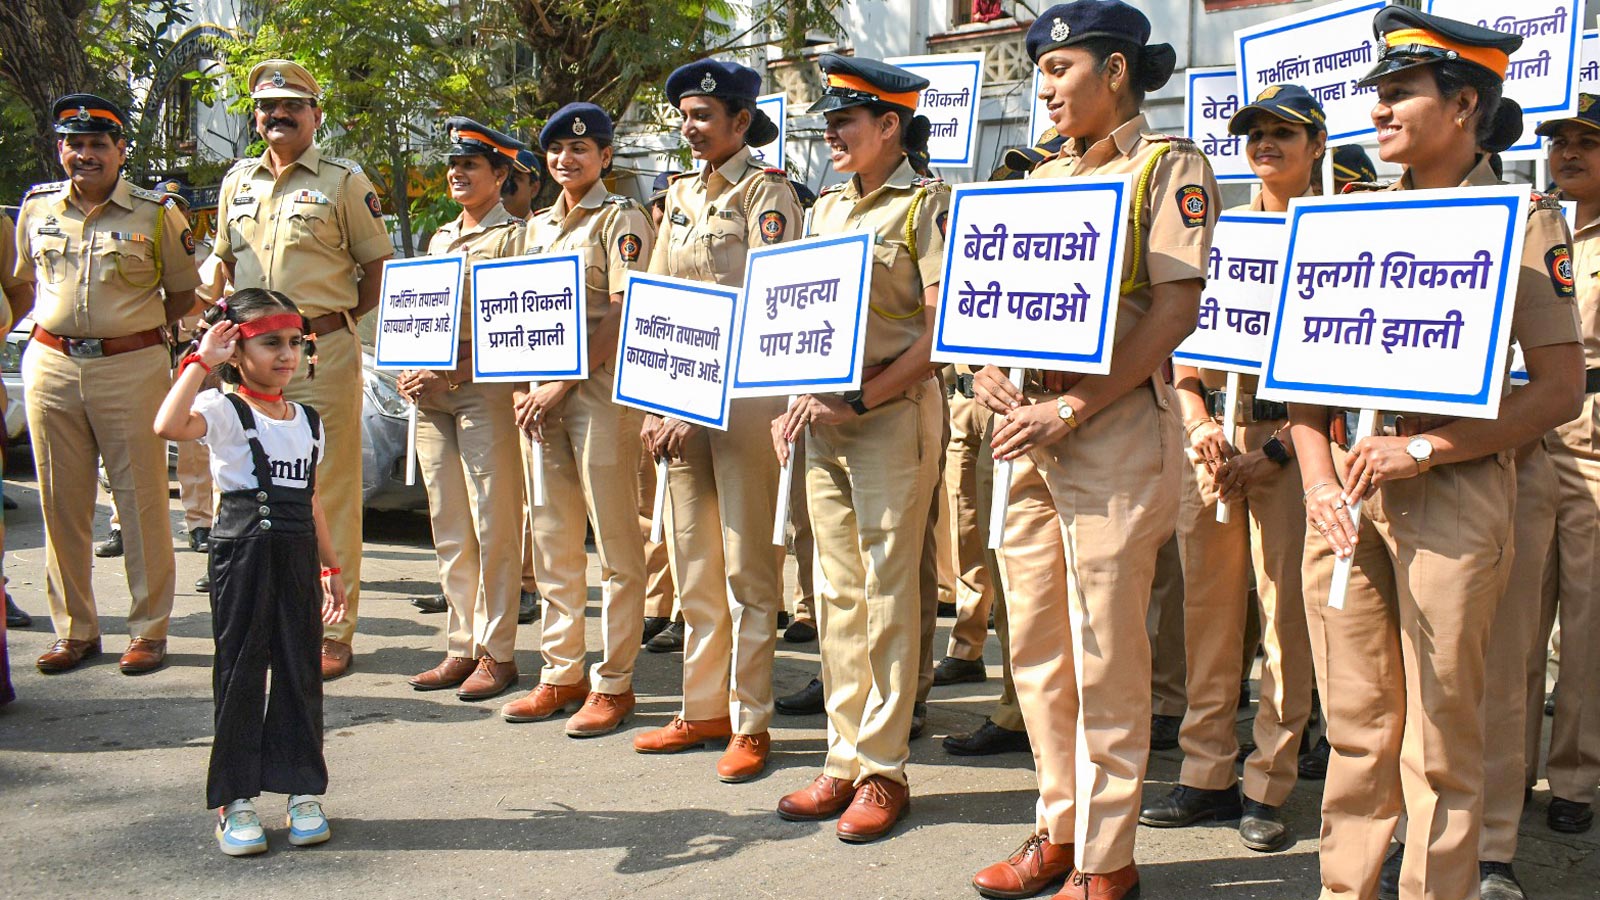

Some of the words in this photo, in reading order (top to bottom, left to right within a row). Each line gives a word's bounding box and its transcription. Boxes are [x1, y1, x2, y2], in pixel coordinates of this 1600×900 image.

[1257, 54, 1310, 85] गर्भलिंग
[1312, 40, 1372, 74] तपासणी
[923, 87, 970, 108] शिकली
[1201, 95, 1239, 120] बेटी
[963, 223, 1009, 261] बेटी
[1013, 221, 1100, 261] बचाओ
[1227, 256, 1279, 285] बचा
[1296, 250, 1376, 300] मुलगी
[1379, 249, 1494, 289] शिकली
[389, 288, 418, 309] गर्भलिंग
[418, 286, 451, 308] तपासणी
[479, 290, 519, 323] मुलगी
[520, 286, 573, 313] शिकली
[765, 277, 841, 321] भ्रुणहत्या
[958, 280, 1003, 319] बेटी
[1006, 282, 1091, 322] पढाओ
[383, 314, 414, 334] कायद्याने
[414, 317, 434, 339] गुन्हा
[434, 312, 452, 333] आहे.
[488, 324, 525, 348] प्रगती
[526, 322, 566, 351] झाली
[635, 314, 676, 342] गर्भलिंग
[676, 326, 721, 351] तपासणी
[759, 331, 794, 357] पाप
[795, 319, 836, 357] आहे
[1225, 307, 1271, 336] पढा
[1301, 307, 1377, 346] प्रगती
[1381, 309, 1465, 354] झाली
[626, 346, 670, 371] कायद्याने
[669, 355, 697, 380] गुन्हा
[697, 358, 722, 384] आहे.
